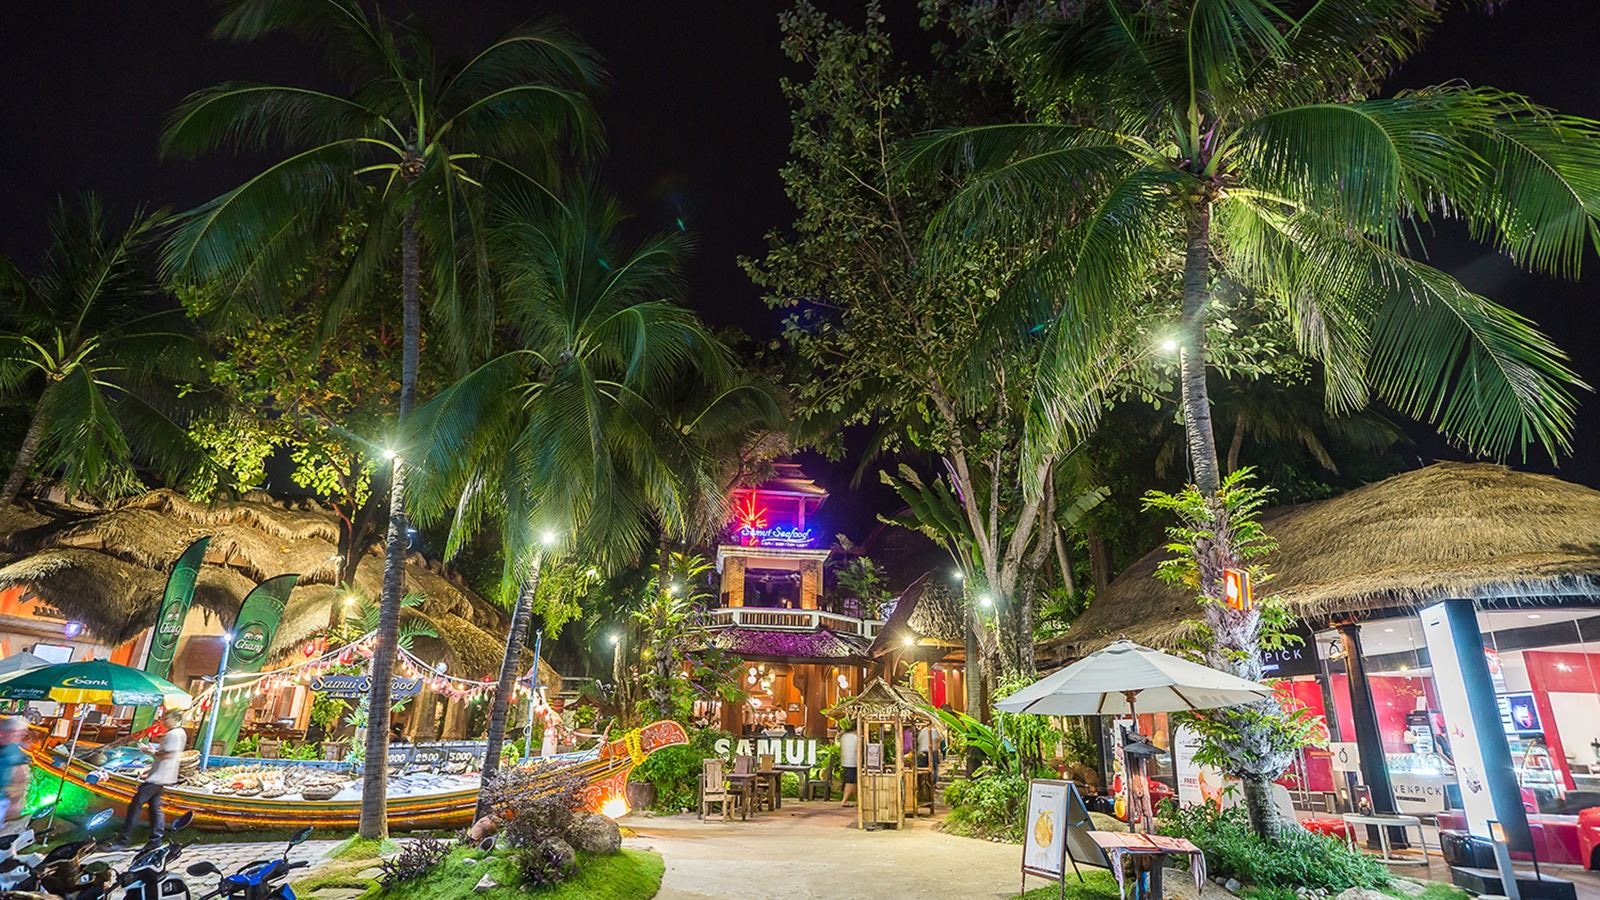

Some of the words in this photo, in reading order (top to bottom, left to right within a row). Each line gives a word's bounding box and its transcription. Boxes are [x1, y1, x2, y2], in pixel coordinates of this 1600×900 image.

[772, 526, 812, 540] Seafood
[235, 640, 263, 652] Chang
[1264, 649, 1303, 662] PICK
[74, 676, 109, 687] bank
[310, 675, 359, 691] Samui
[358, 674, 419, 691] Sood
[448, 752, 472, 762] 5000
[714, 738, 817, 765] SAMUI
[415, 753, 440, 763] 2500
[1393, 784, 1442, 796] VENPICK
